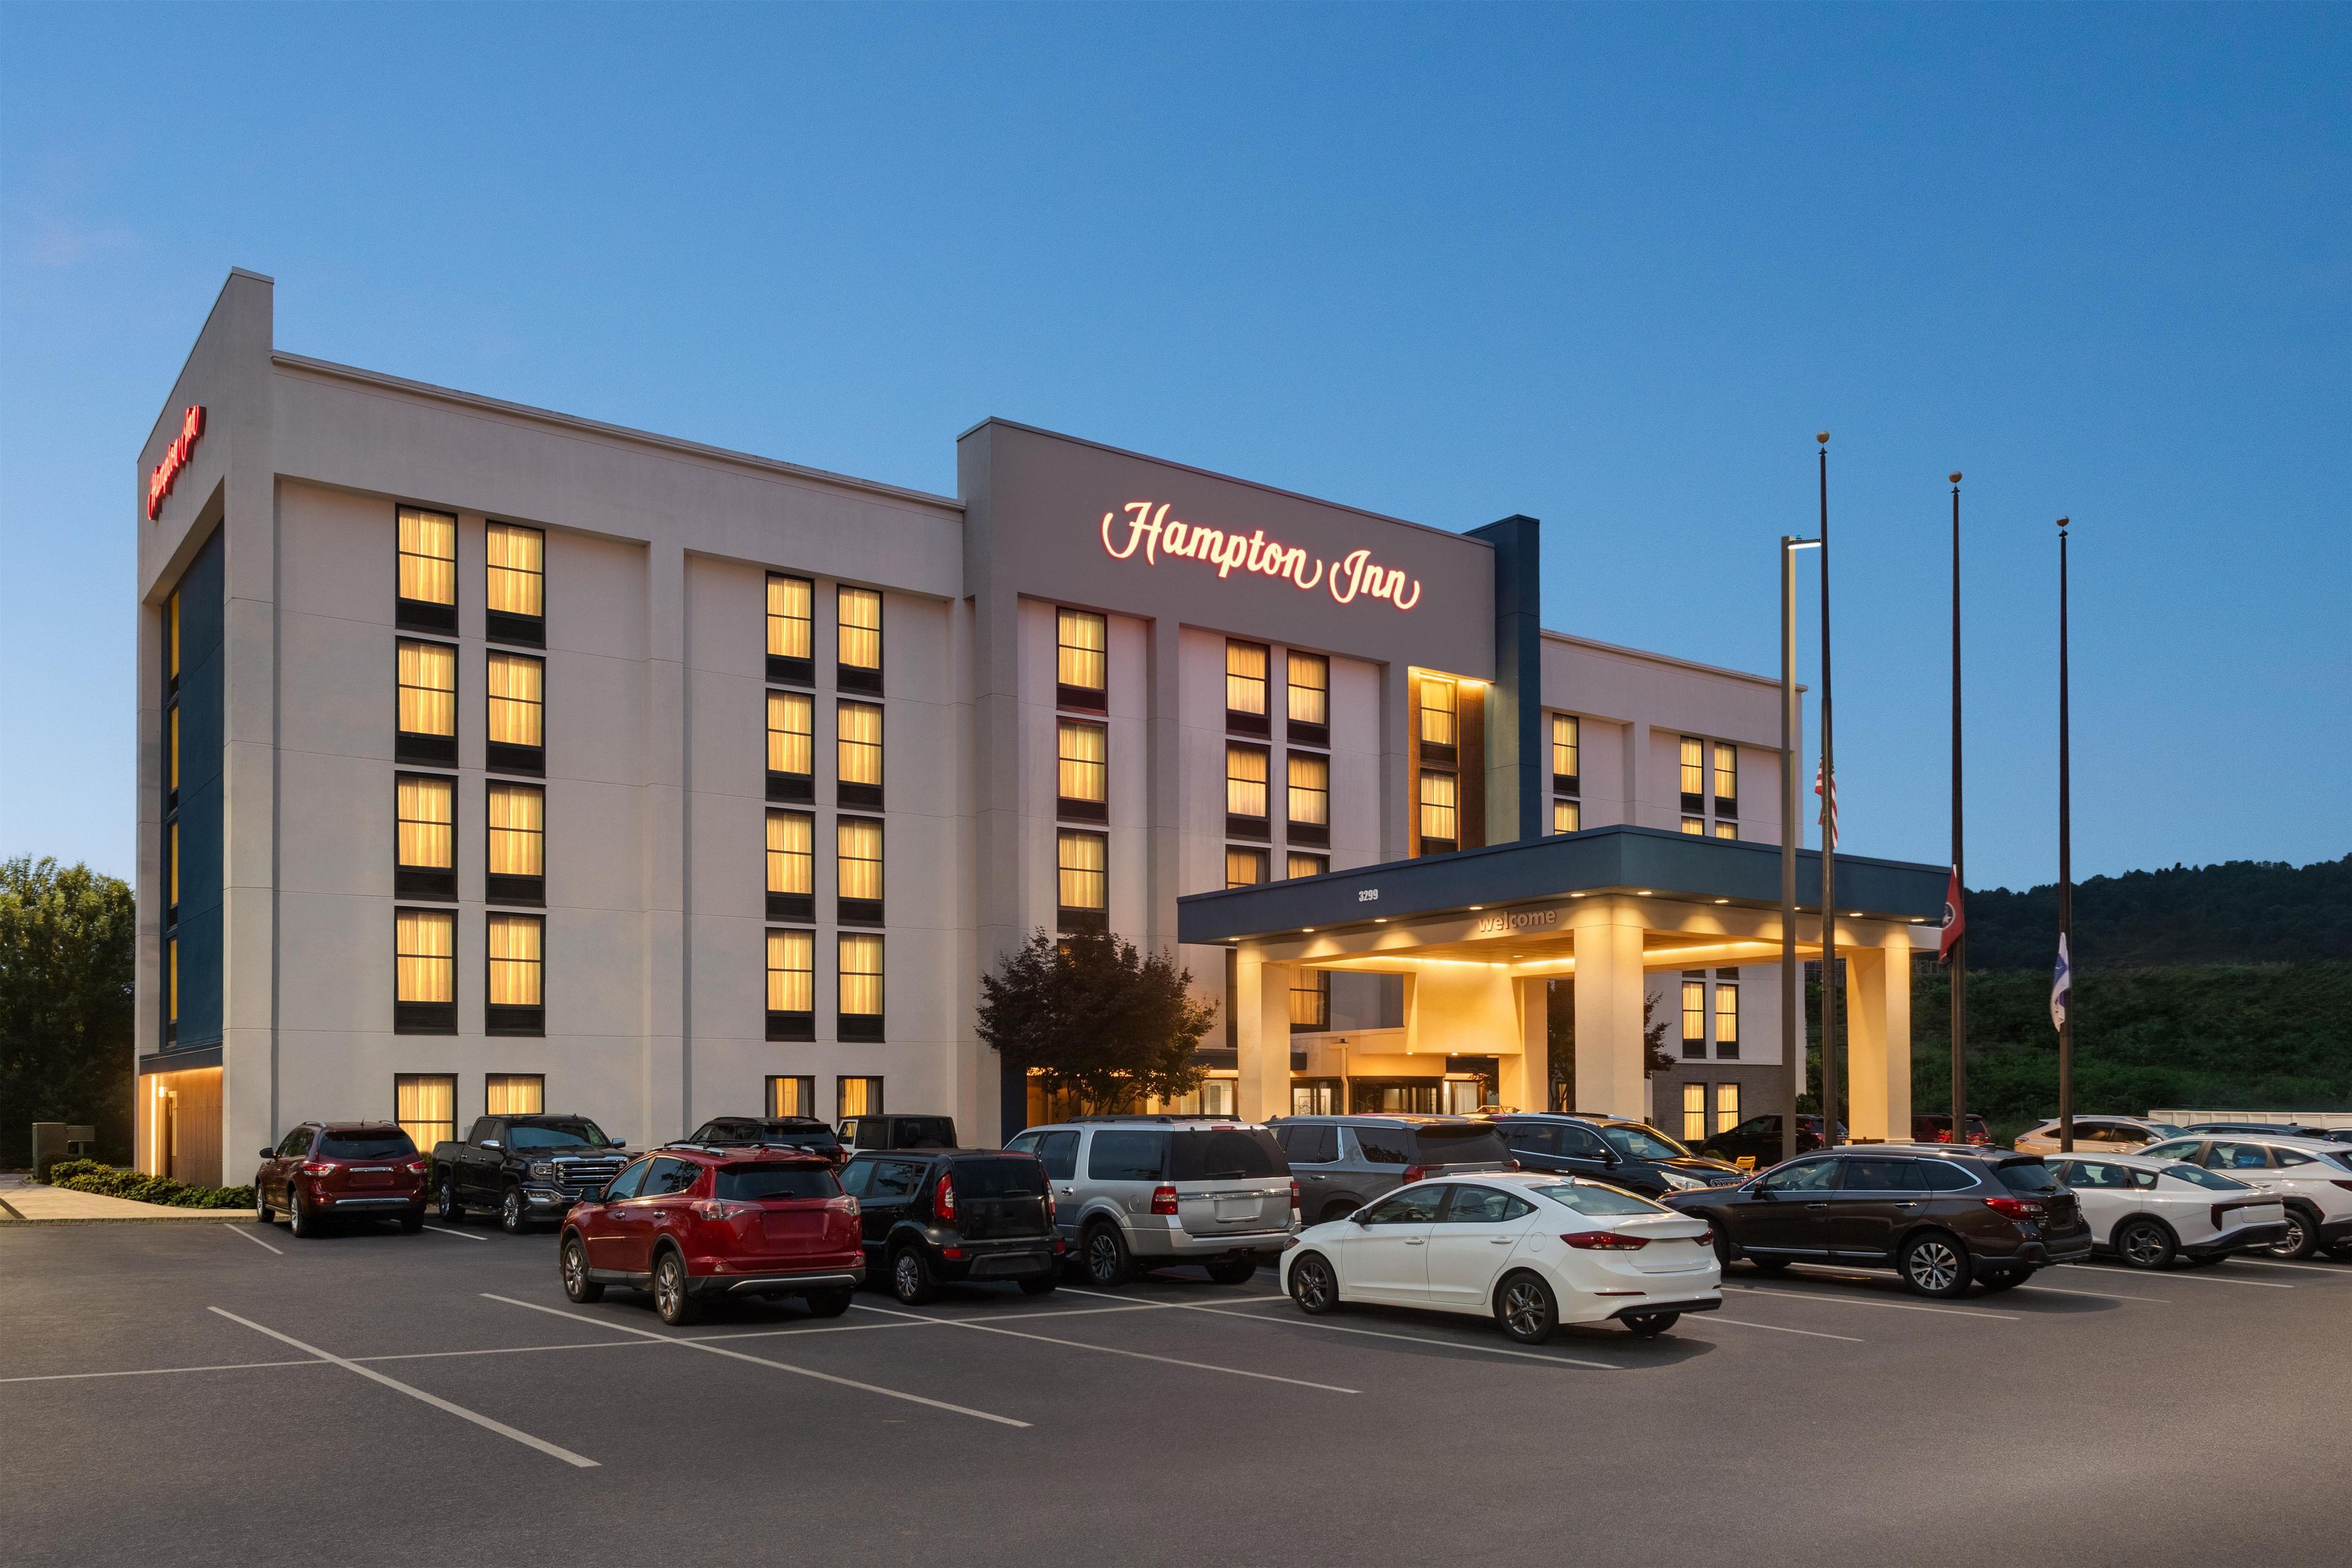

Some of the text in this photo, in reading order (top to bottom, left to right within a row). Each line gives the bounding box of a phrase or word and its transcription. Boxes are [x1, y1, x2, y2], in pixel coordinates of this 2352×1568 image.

[1102, 502, 1420, 610] Hampton Inn
[1359, 889, 1379, 902] 3299
[1478, 910, 1556, 932] welcome
